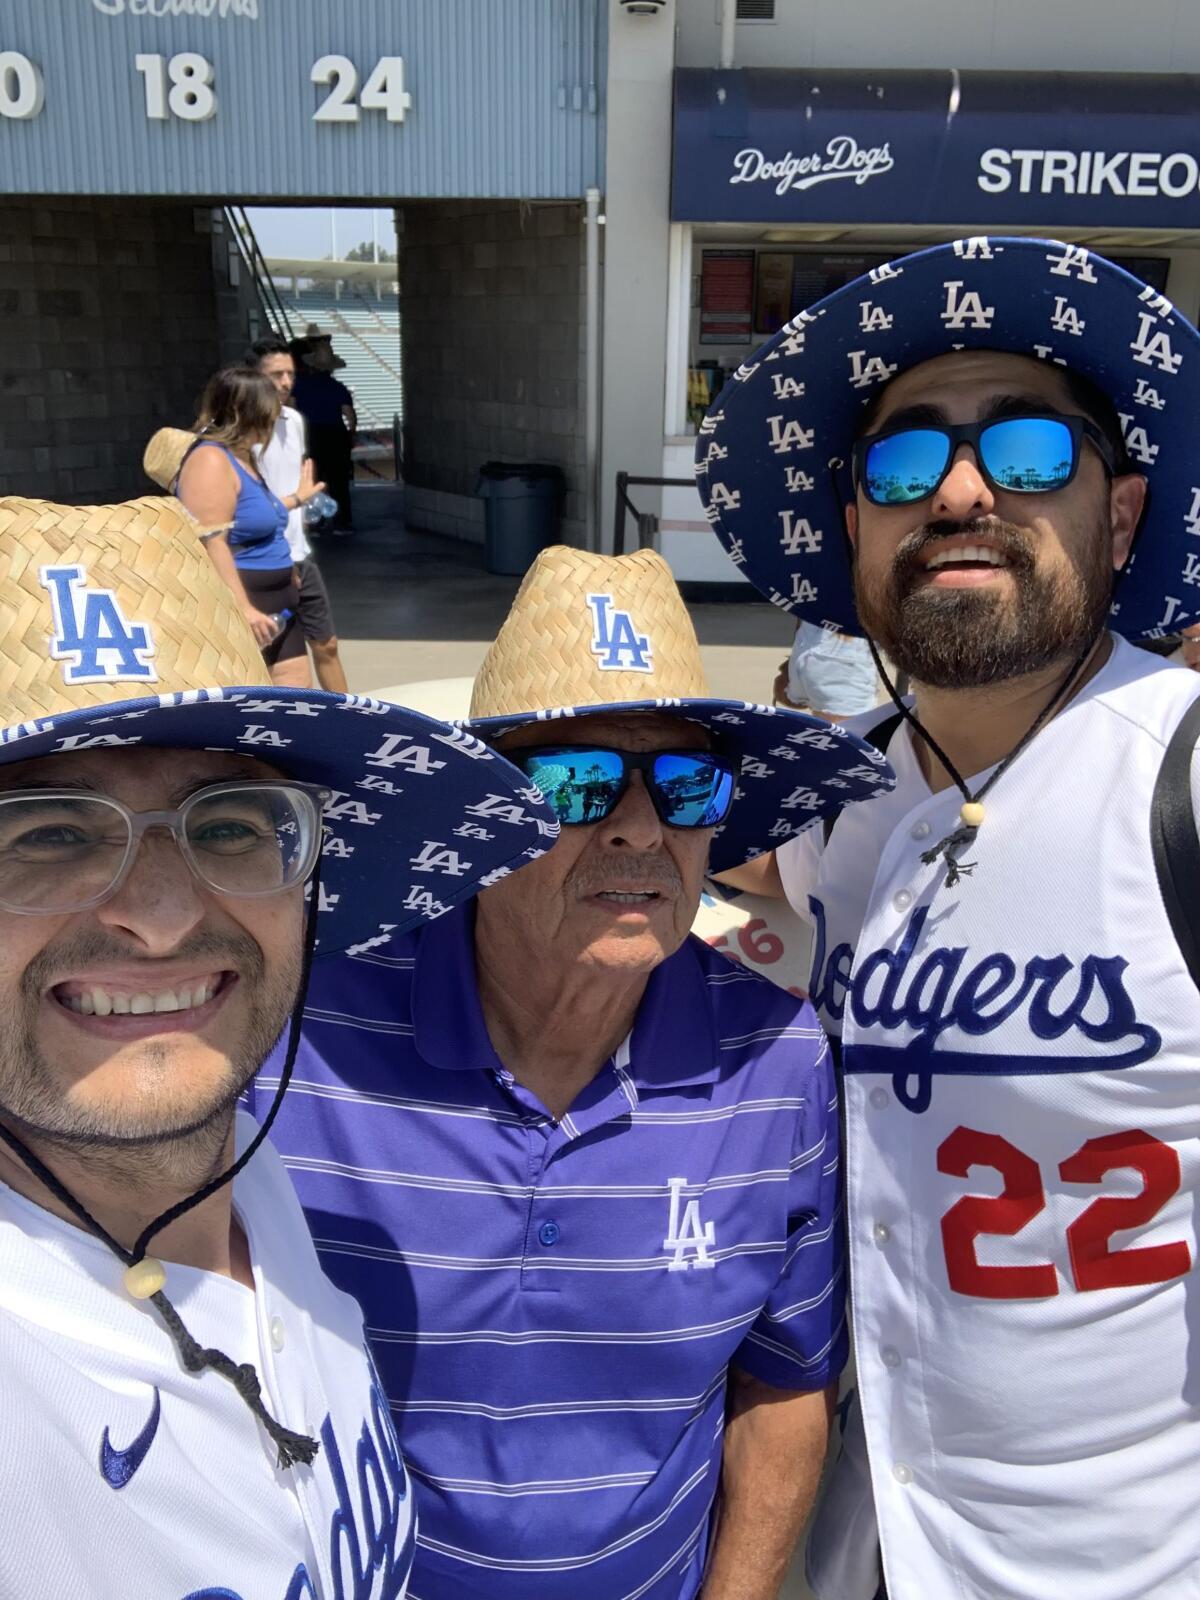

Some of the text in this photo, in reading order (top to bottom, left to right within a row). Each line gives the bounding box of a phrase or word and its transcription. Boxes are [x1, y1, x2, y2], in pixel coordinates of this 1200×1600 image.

[135, 53, 217, 121] 18
[310, 54, 411, 122] 24
[729, 136, 895, 195] Dodger Dogs
[978, 147, 1200, 198] STRIKEO
[859, 301, 894, 333] LA
[940, 281, 995, 329] LA
[1050, 296, 1086, 336] LA
[1130, 312, 1183, 375] LA
[771, 374, 805, 400] LA
[847, 350, 898, 389] LA
[1133, 378, 1167, 410] LA
[707, 441, 728, 462] A
[767, 415, 814, 454] LA
[709, 481, 741, 511] A
[784, 466, 814, 493] LA
[778, 509, 823, 556] LA
[790, 573, 818, 604] LA
[42, 566, 156, 683] LA
[588, 594, 652, 672] LA
[236, 724, 292, 747] LA
[769, 745, 801, 761] LA
[785, 727, 840, 751] LA
[364, 733, 448, 776] LA
[354, 774, 404, 796] LA
[780, 786, 827, 811] LA
[464, 793, 536, 826] LA
[321, 837, 355, 858] A
[452, 821, 496, 841] LA
[409, 840, 472, 877] LA
[663, 1177, 716, 1272] LA
[937, 1125, 1191, 1299] 22
